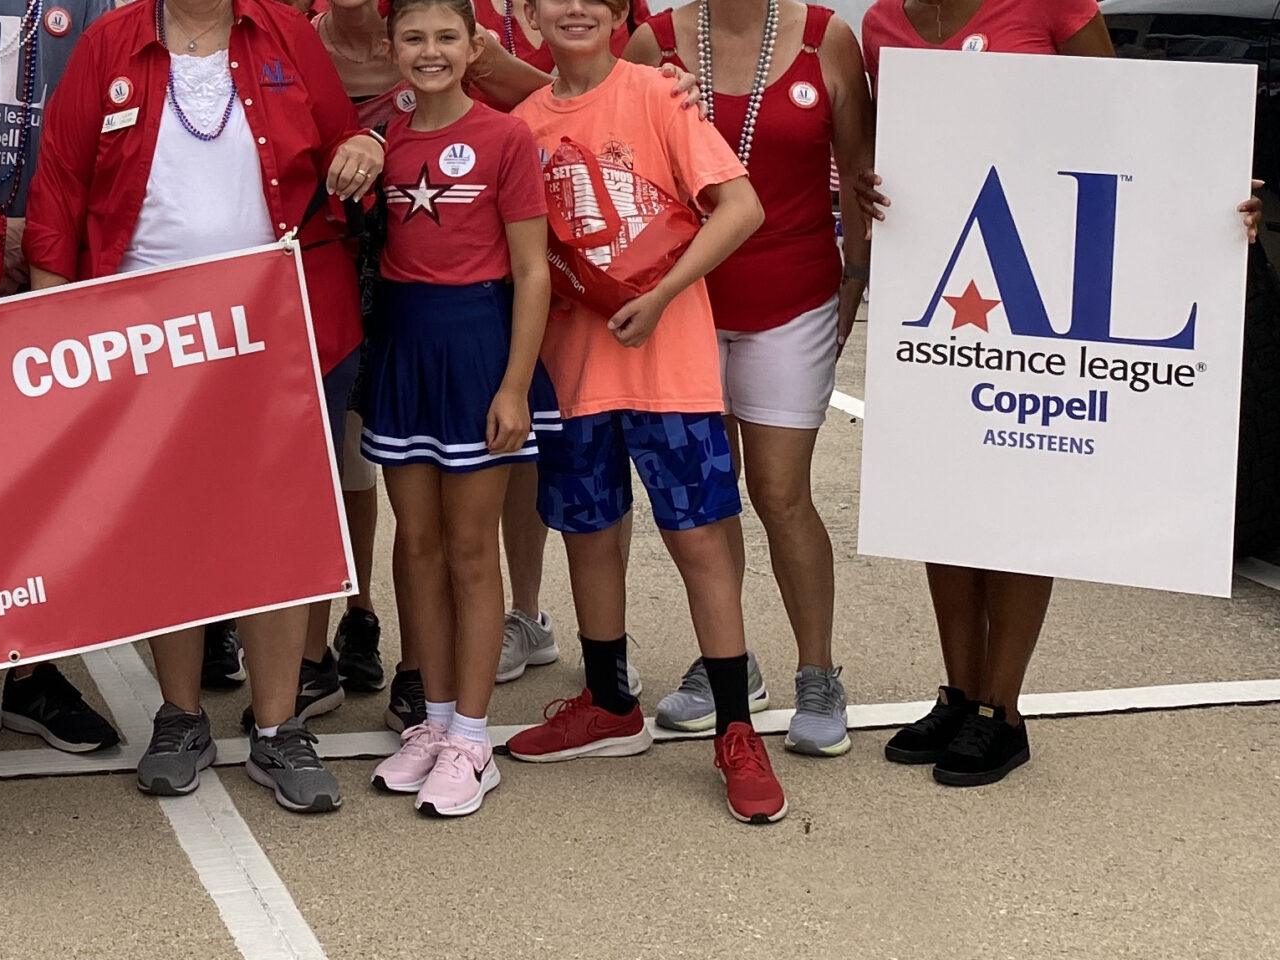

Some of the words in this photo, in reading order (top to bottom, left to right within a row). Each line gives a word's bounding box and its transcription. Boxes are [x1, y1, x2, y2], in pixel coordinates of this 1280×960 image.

[445, 145, 471, 159] AL
[552, 165, 572, 180] SET
[602, 167, 634, 183] GOALS
[901, 164, 1198, 351] AL
[11, 304, 266, 398] COPPELL
[895, 336, 1066, 376] assistance
[970, 382, 1109, 426] Coppell
[982, 428, 1096, 456] ASSISTEENS
